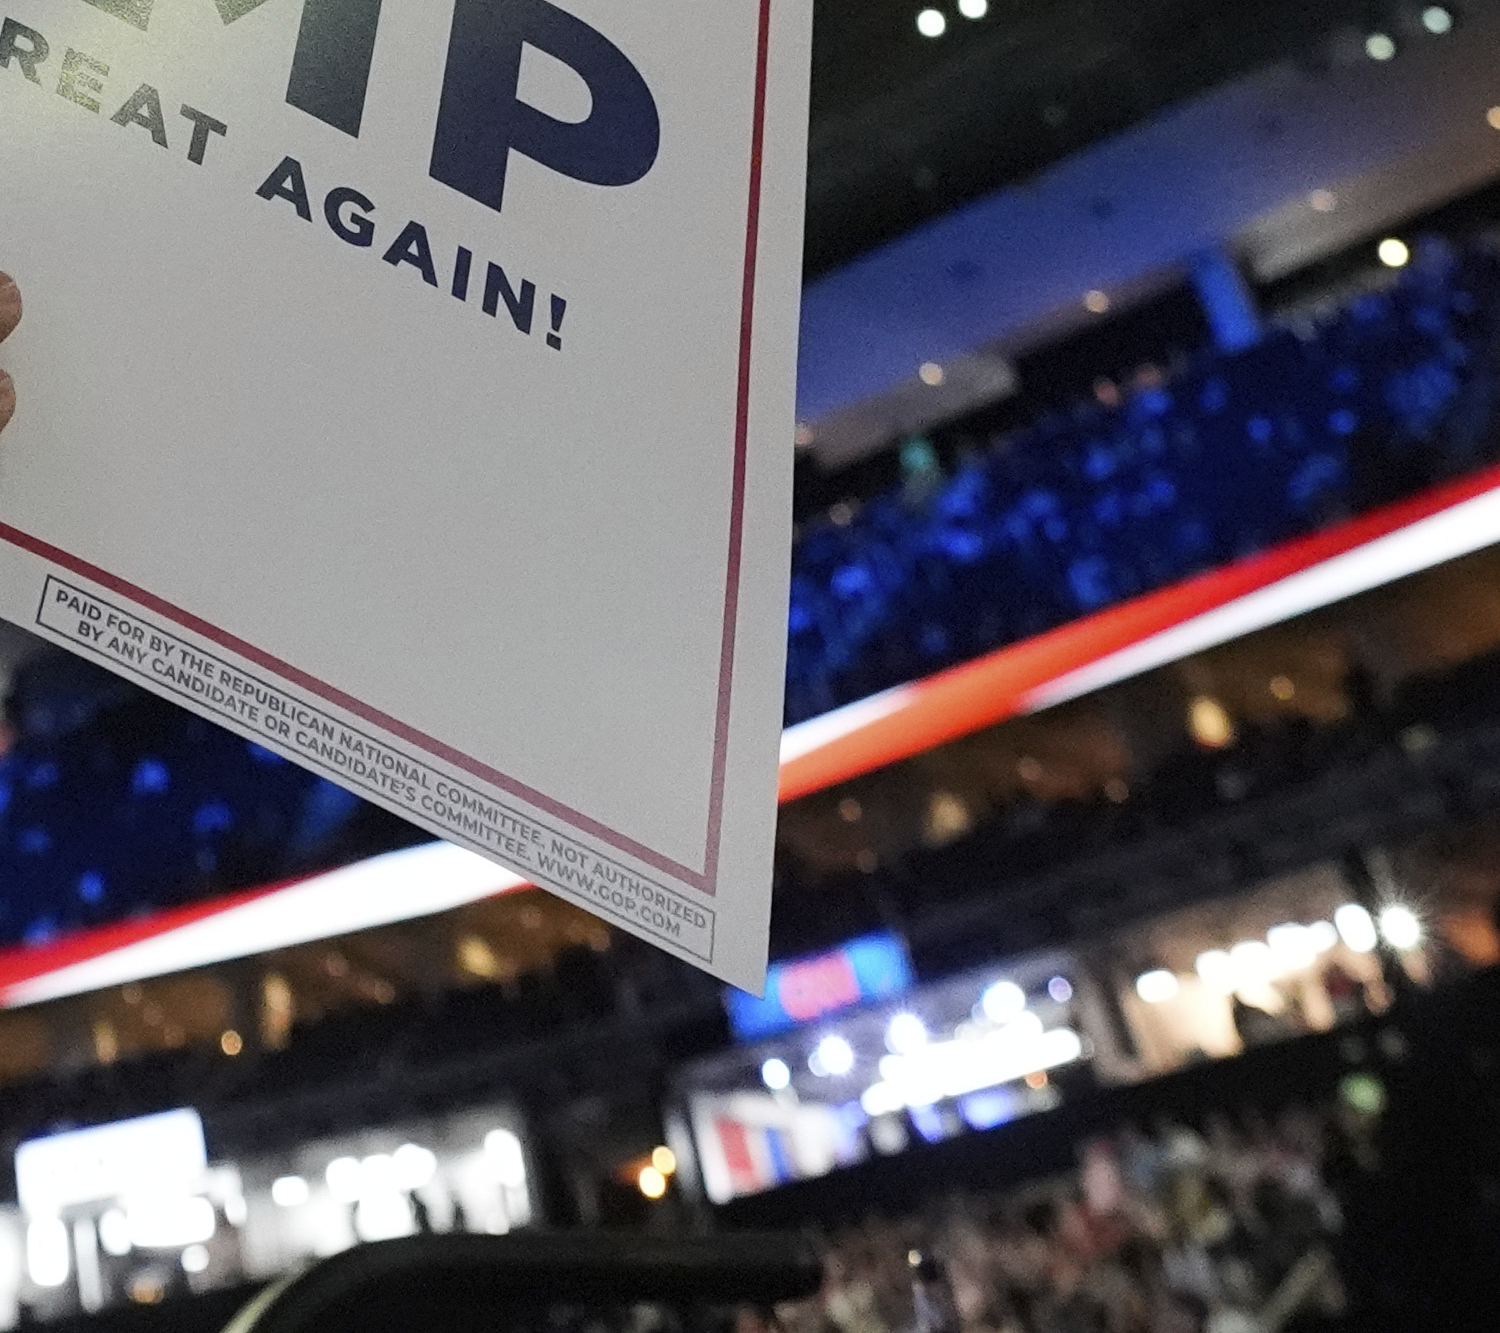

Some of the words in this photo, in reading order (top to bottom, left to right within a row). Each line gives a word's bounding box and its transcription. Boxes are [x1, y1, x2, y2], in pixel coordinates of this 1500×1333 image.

[253, 155, 568, 353] AGAIN!
[56, 588, 102, 621] PAID
[106, 613, 145, 645] FOR
[149, 634, 176, 657] BY
[179, 648, 216, 680] THE
[218, 668, 335, 742] REPUBLICAN
[339, 731, 432, 792] NATIONAL
[551, 839, 589, 869] NOT
[592, 861, 706, 930] AUTHORIZED
[77, 620, 104, 642] BY
[106, 636, 149, 665] ANY
[151, 657, 260, 724] CANDIDATE
[264, 714, 291, 741] OR
[537, 851, 682, 937] WWW.GOP.COM
